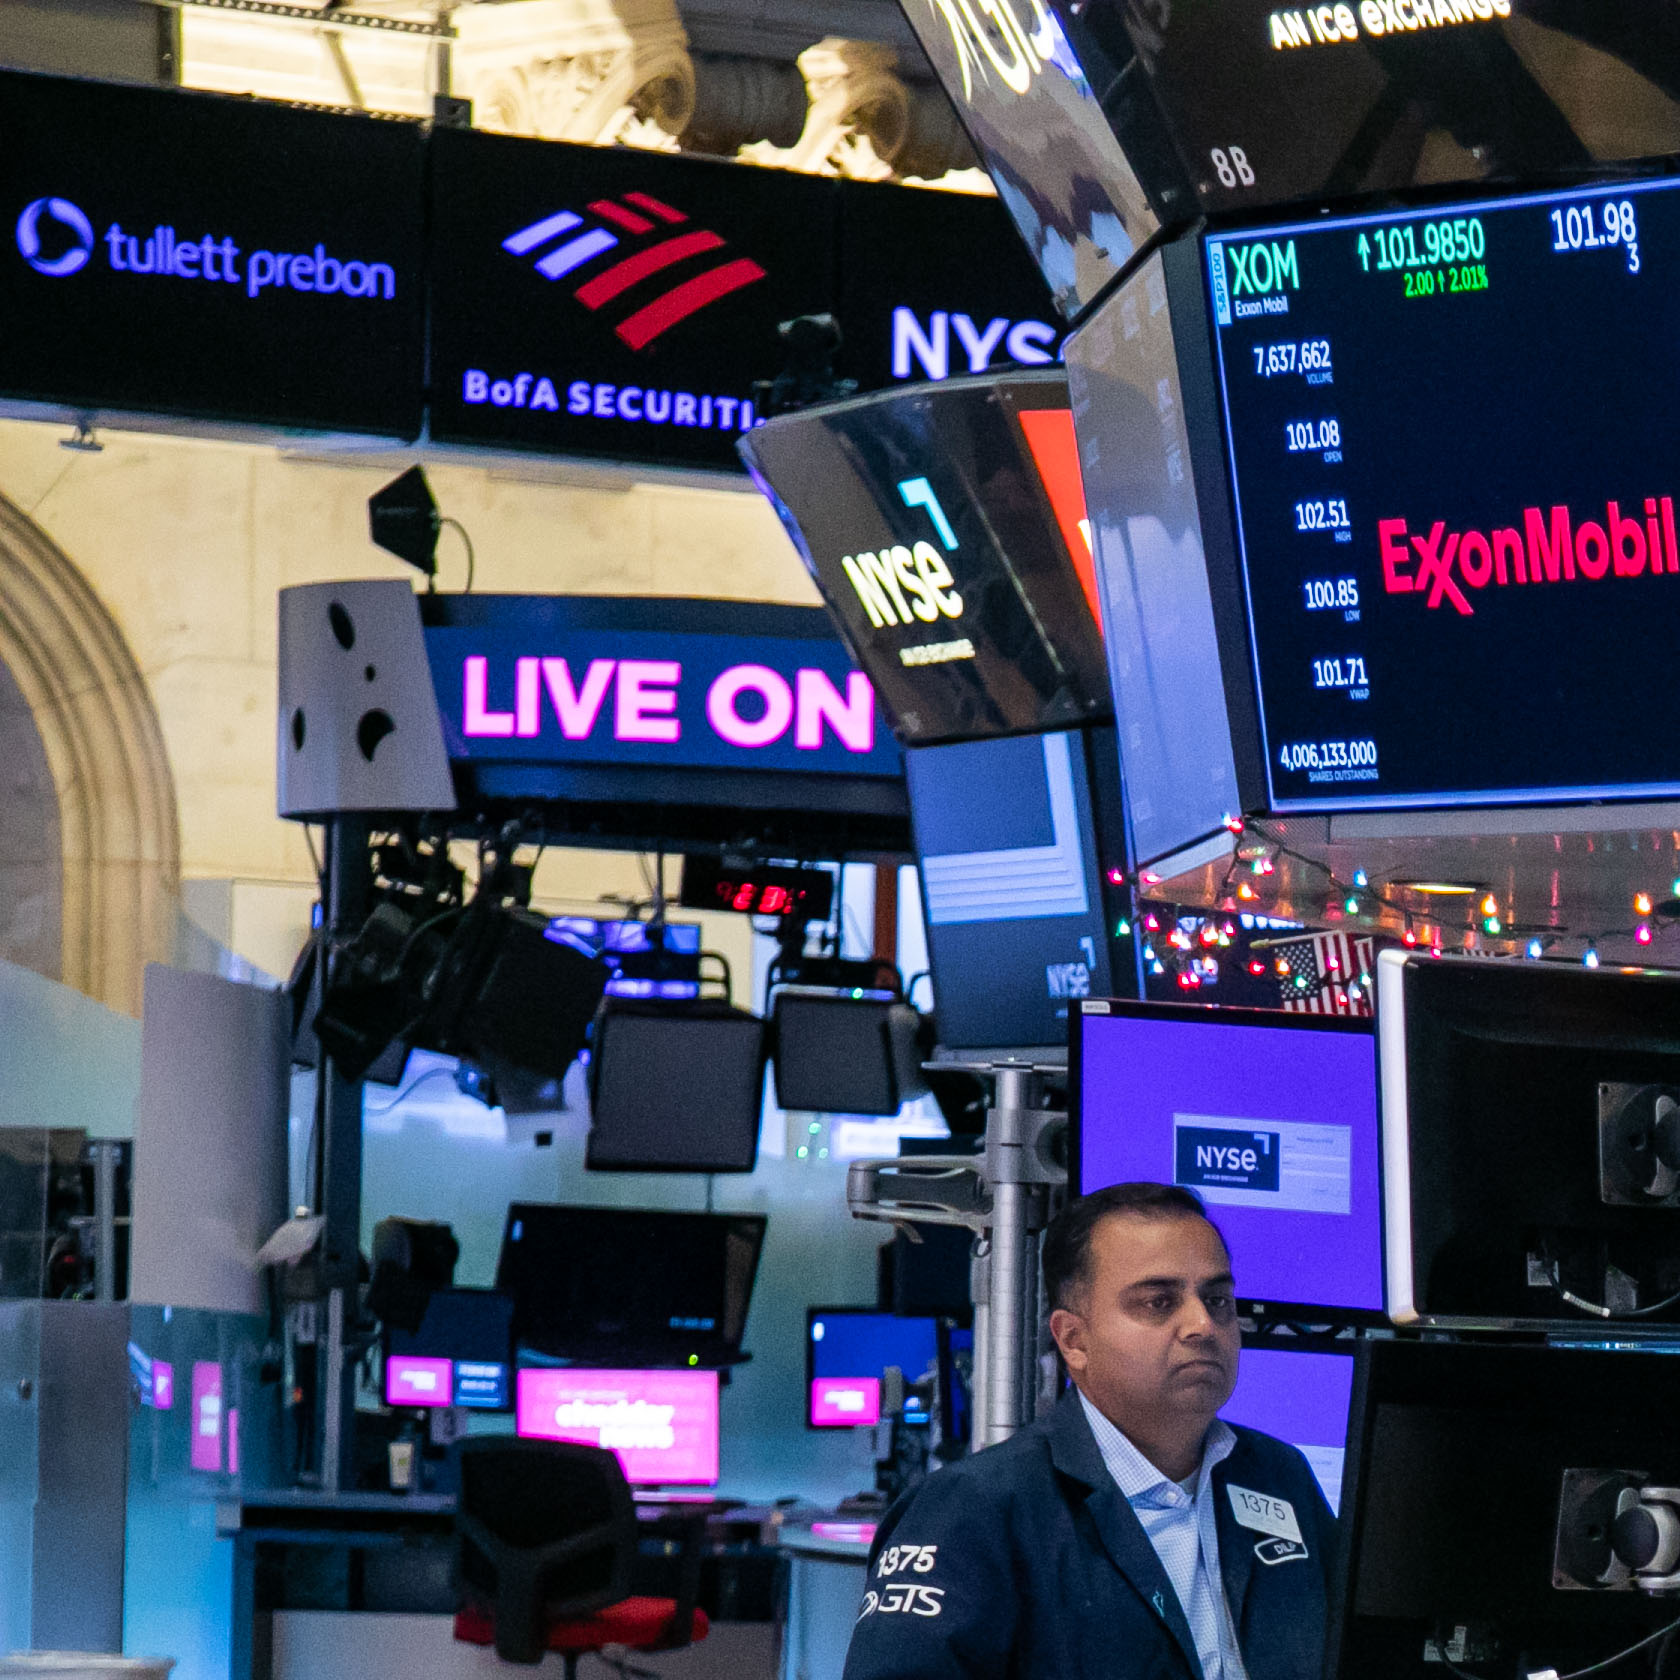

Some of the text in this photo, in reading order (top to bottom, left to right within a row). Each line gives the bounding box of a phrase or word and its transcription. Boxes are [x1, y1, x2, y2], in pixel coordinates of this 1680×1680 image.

[1270, 11, 1311, 50] AN
[1211, 146, 1255, 187] 8B
[1551, 201, 1636, 250] 101.98
[104, 221, 395, 300] tullett prebon
[1374, 218, 1485, 271] 101.9850
[1627, 243, 1640, 271] 3
[1213, 240, 1299, 312] S&P100 XOM
[1404, 264, 1488, 297] 2.00 2.01%
[1235, 295, 1289, 317] Exxon Mobil
[891, 306, 1064, 380] NYS
[1254, 340, 1331, 377] 7,637,662
[1306, 372, 1333, 384] VOLUME
[463, 368, 764, 431] BofA SECURITI
[1287, 420, 1340, 450] 101.08
[1324, 451, 1343, 463] OPEN
[1296, 500, 1350, 530] 102.51
[1378, 496, 1680, 615] ExxonMobil
[1305, 579, 1359, 609] 100.85
[1344, 610, 1360, 622] LOW
[1314, 658, 1368, 686] 101.71
[463, 655, 874, 753] LIVE ON
[1281, 741, 1377, 771] 4,006,133,000
[1240, 1493, 1286, 1520] 1375
[877, 1544, 938, 1578] 1375
[878, 1583, 945, 1617] GTS
